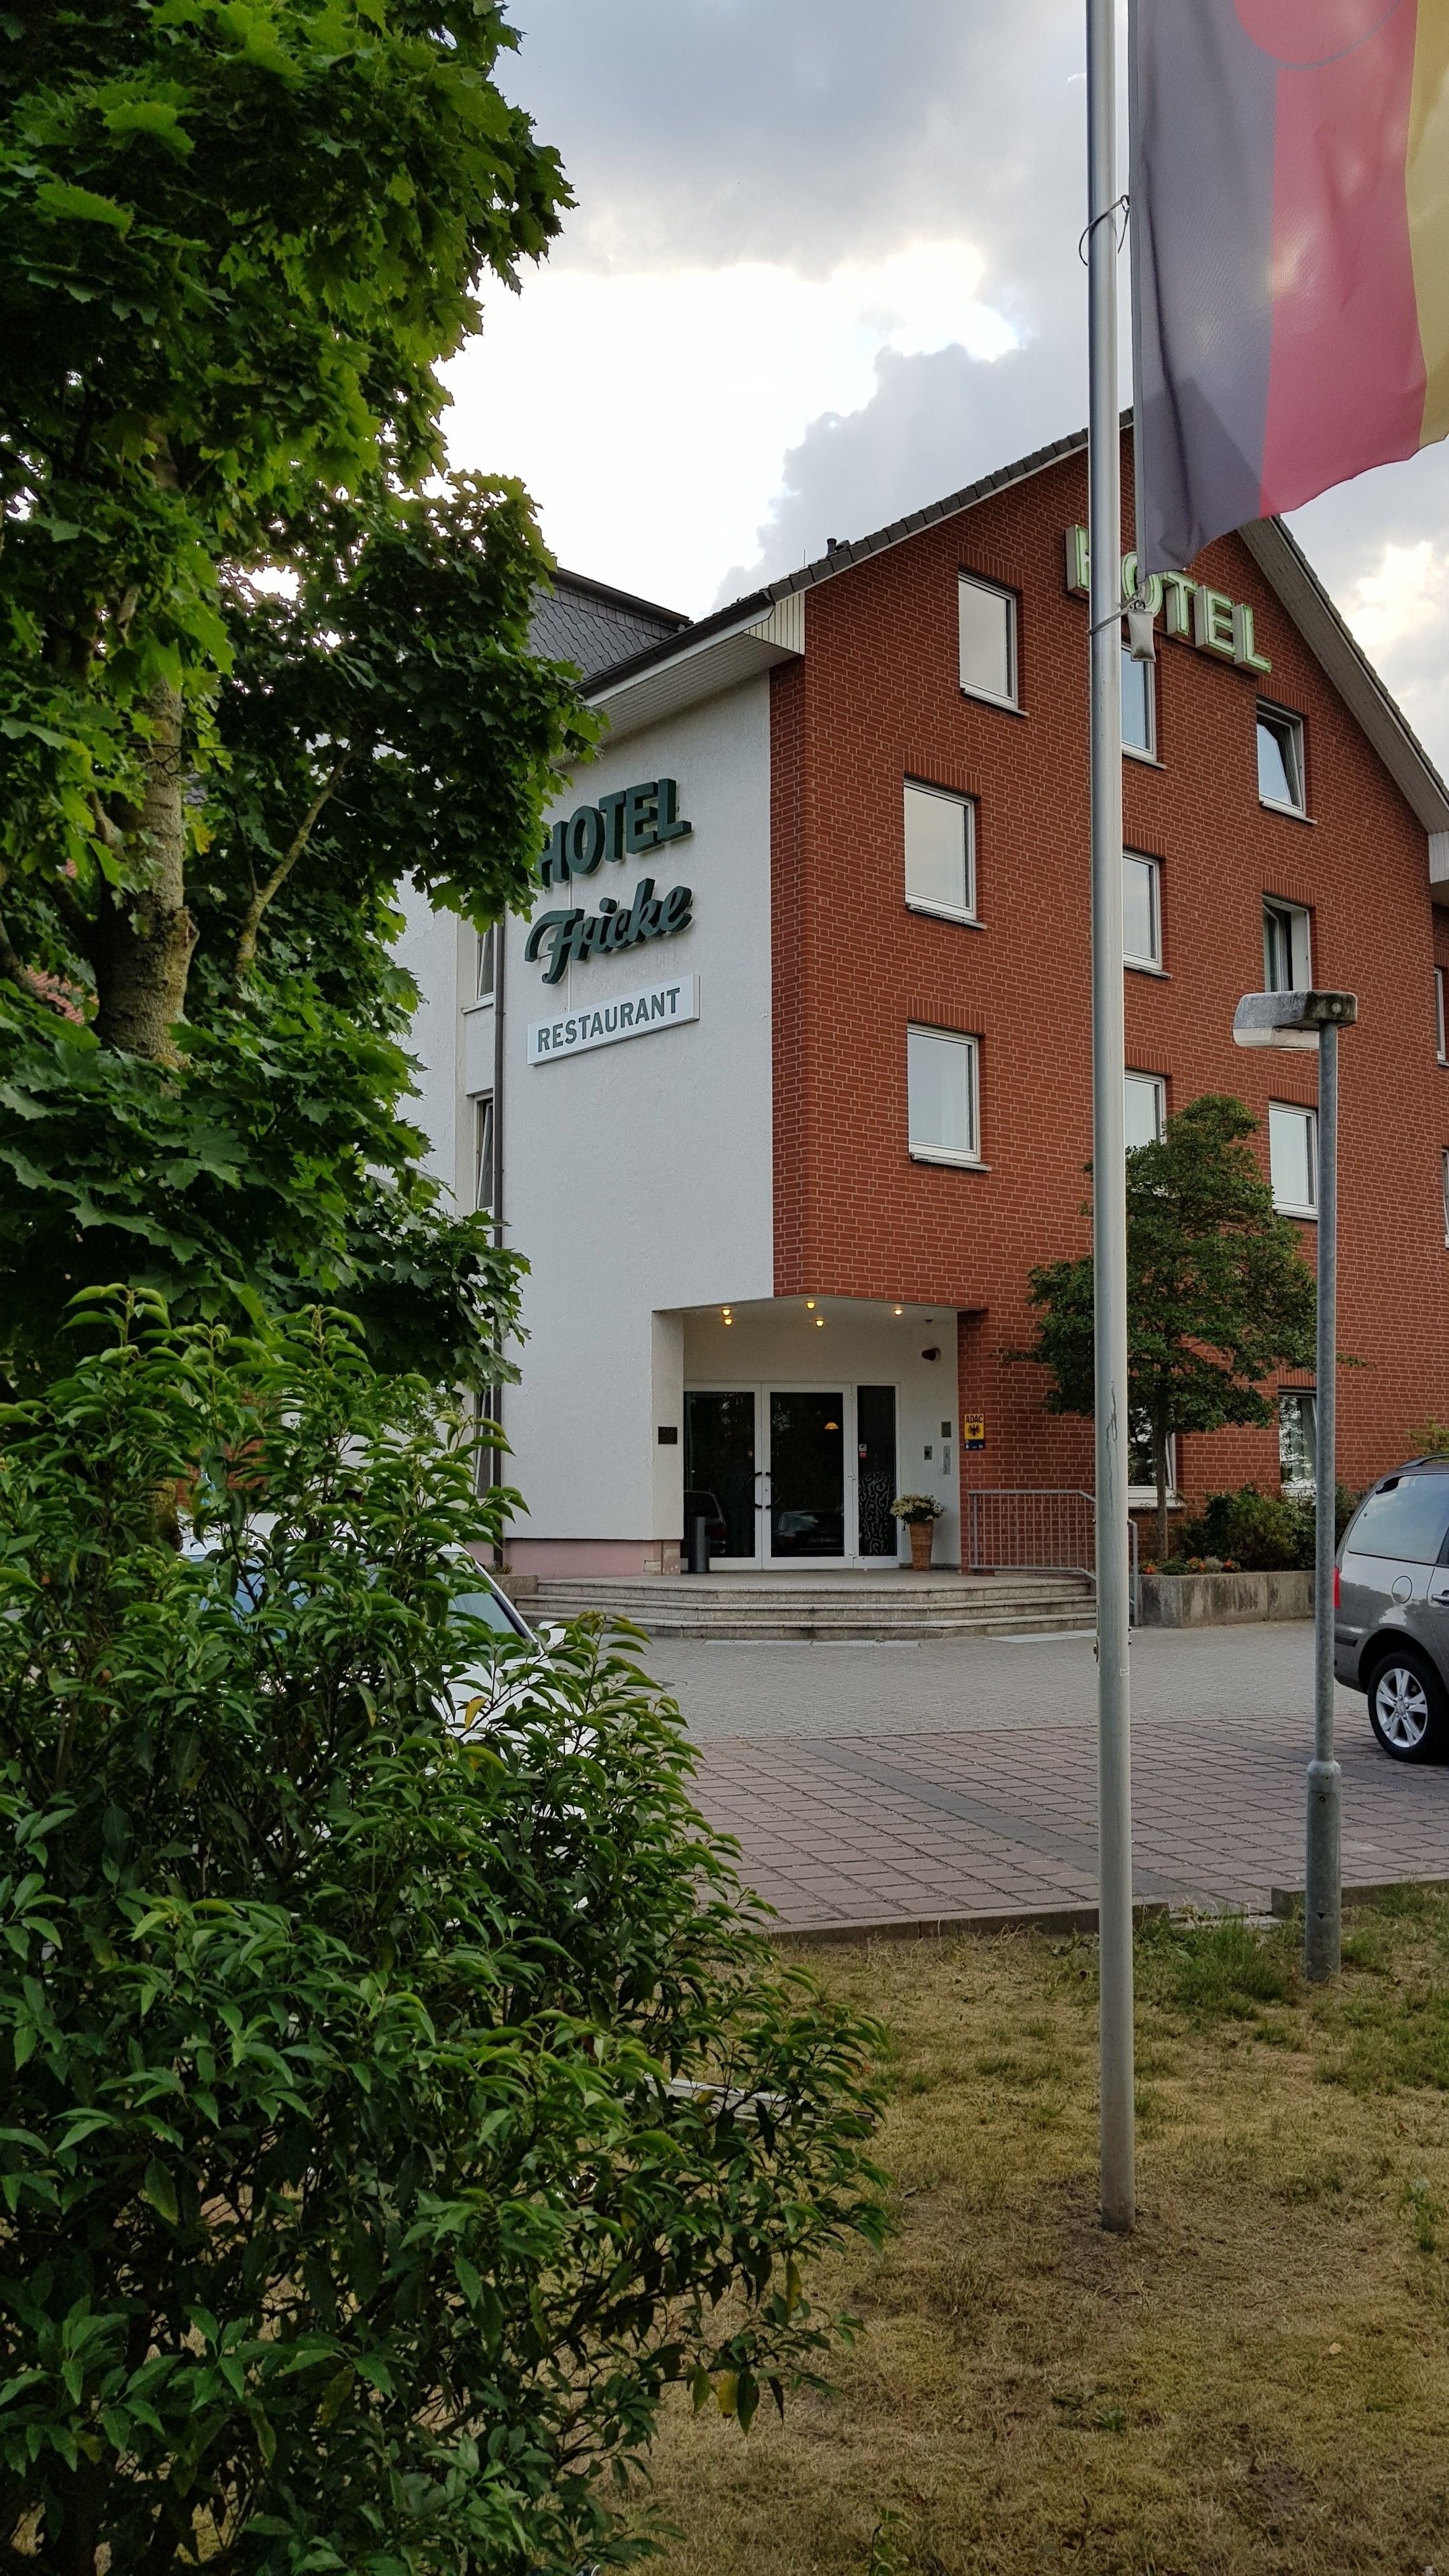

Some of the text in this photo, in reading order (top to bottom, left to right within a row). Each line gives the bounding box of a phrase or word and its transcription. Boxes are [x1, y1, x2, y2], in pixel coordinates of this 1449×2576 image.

[537, 778, 692, 887] HOTEL
[525, 877, 693, 984] Fricke
[537, 987, 681, 1053] RESTAURANT
[966, 1415, 983, 1424] ADAC
